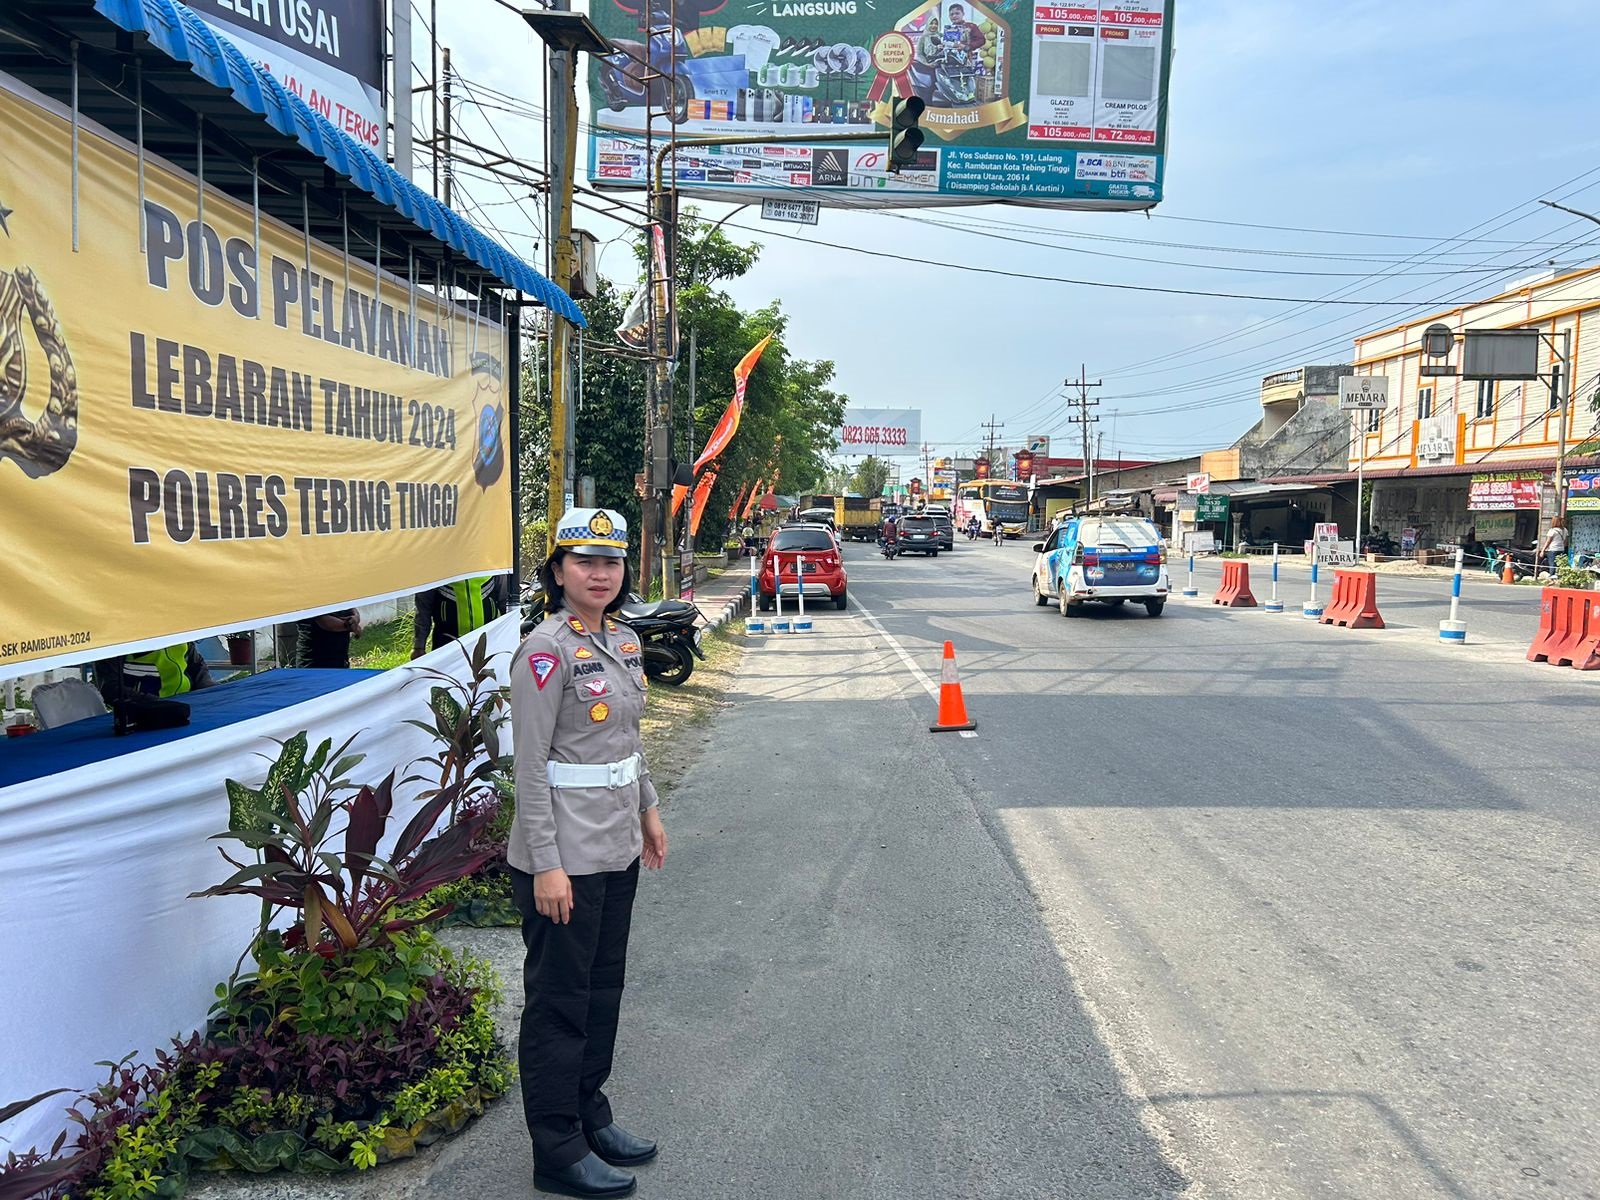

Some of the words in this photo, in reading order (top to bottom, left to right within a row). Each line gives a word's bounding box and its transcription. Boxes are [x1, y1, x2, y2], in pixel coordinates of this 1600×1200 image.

[773, 1, 856, 16] LANGSUNG
[279, 0, 340, 58] USAI
[336, 103, 379, 146] TERUS
[926, 110, 979, 124] Ismahadi
[974, 152, 1004, 160] Sudarso
[1021, 154, 1036, 162] 191,
[1038, 154, 1062, 163] Lalang
[965, 162, 1001, 170] Rambutan
[1022, 164, 1045, 173] Tebing
[1048, 165, 1070, 173] Tinggi
[983, 173, 1004, 181] Utara,
[990, 183, 1019, 191] Sekolah
[144, 199, 260, 320] POS
[273, 255, 449, 378] PELAYANAN
[130, 331, 313, 432] LEBARAN
[319, 378, 402, 444] TAHUN
[408, 399, 456, 450] 2024
[1346, 393, 1386, 403] MENARA
[843, 426, 862, 443] 0823
[882, 427, 906, 445] 33333
[128, 466, 288, 544] POLRES
[294, 477, 391, 535] TEBING
[396, 482, 458, 529] TINGGI
[0, 643, 18, 657] SEK
[21, 631, 90, 654] RAMBUTAN-2024
[573, 662, 605, 677] AGNIS
